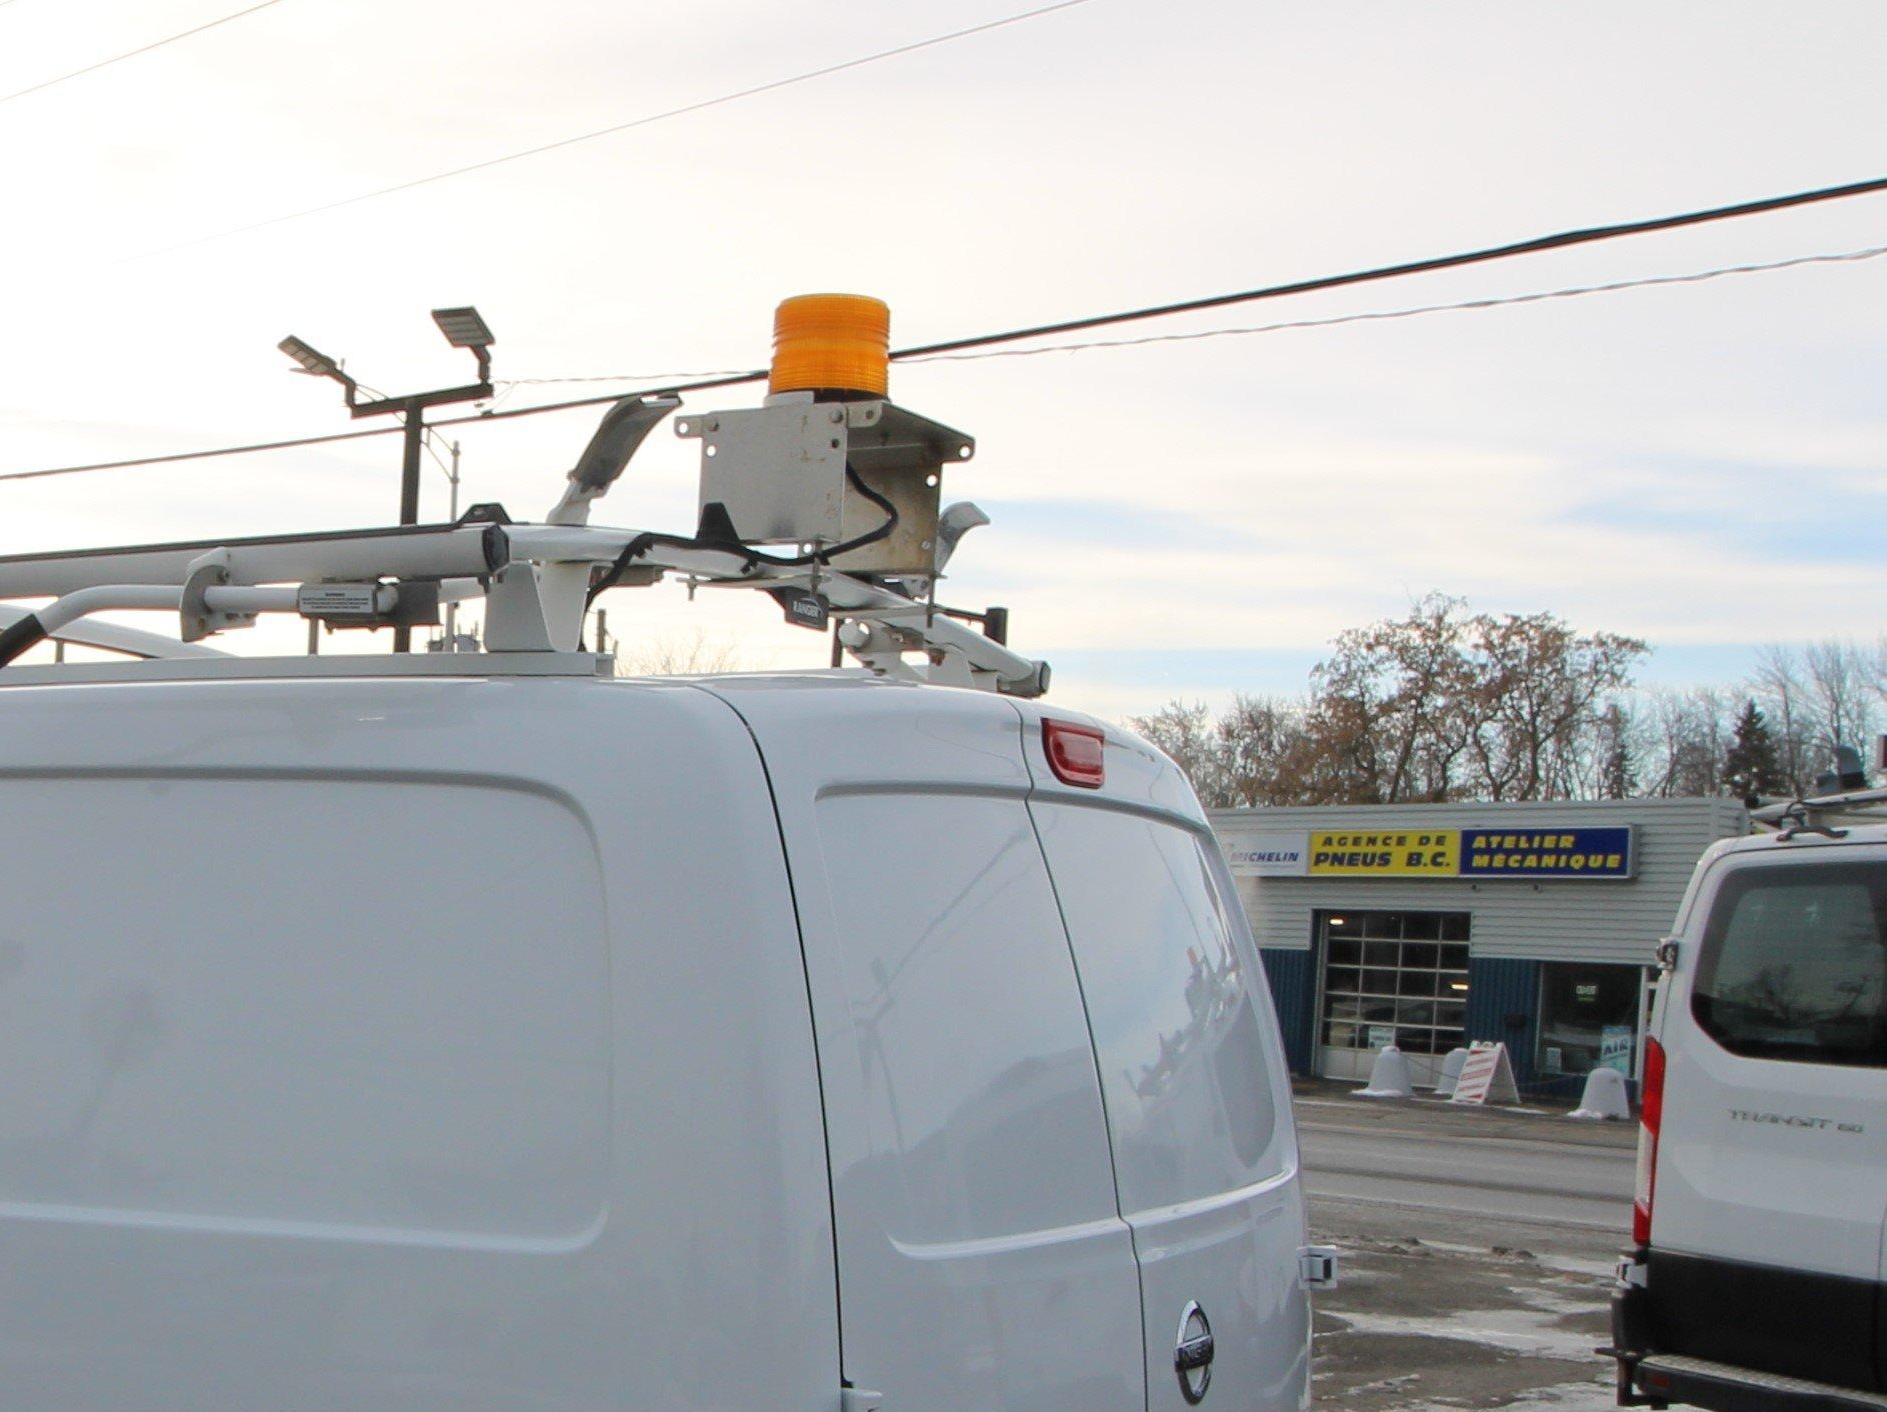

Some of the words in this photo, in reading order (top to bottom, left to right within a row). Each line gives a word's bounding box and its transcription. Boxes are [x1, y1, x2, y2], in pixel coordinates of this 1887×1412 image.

[1321, 836, 1408, 847] AGENCE
[1417, 835, 1447, 846] DE
[1472, 835, 1576, 849] ATELIER
[1313, 850, 1393, 867] PNEUS
[1405, 851, 1451, 867] B.C.
[1471, 853, 1621, 870] MÉCANIQUE
